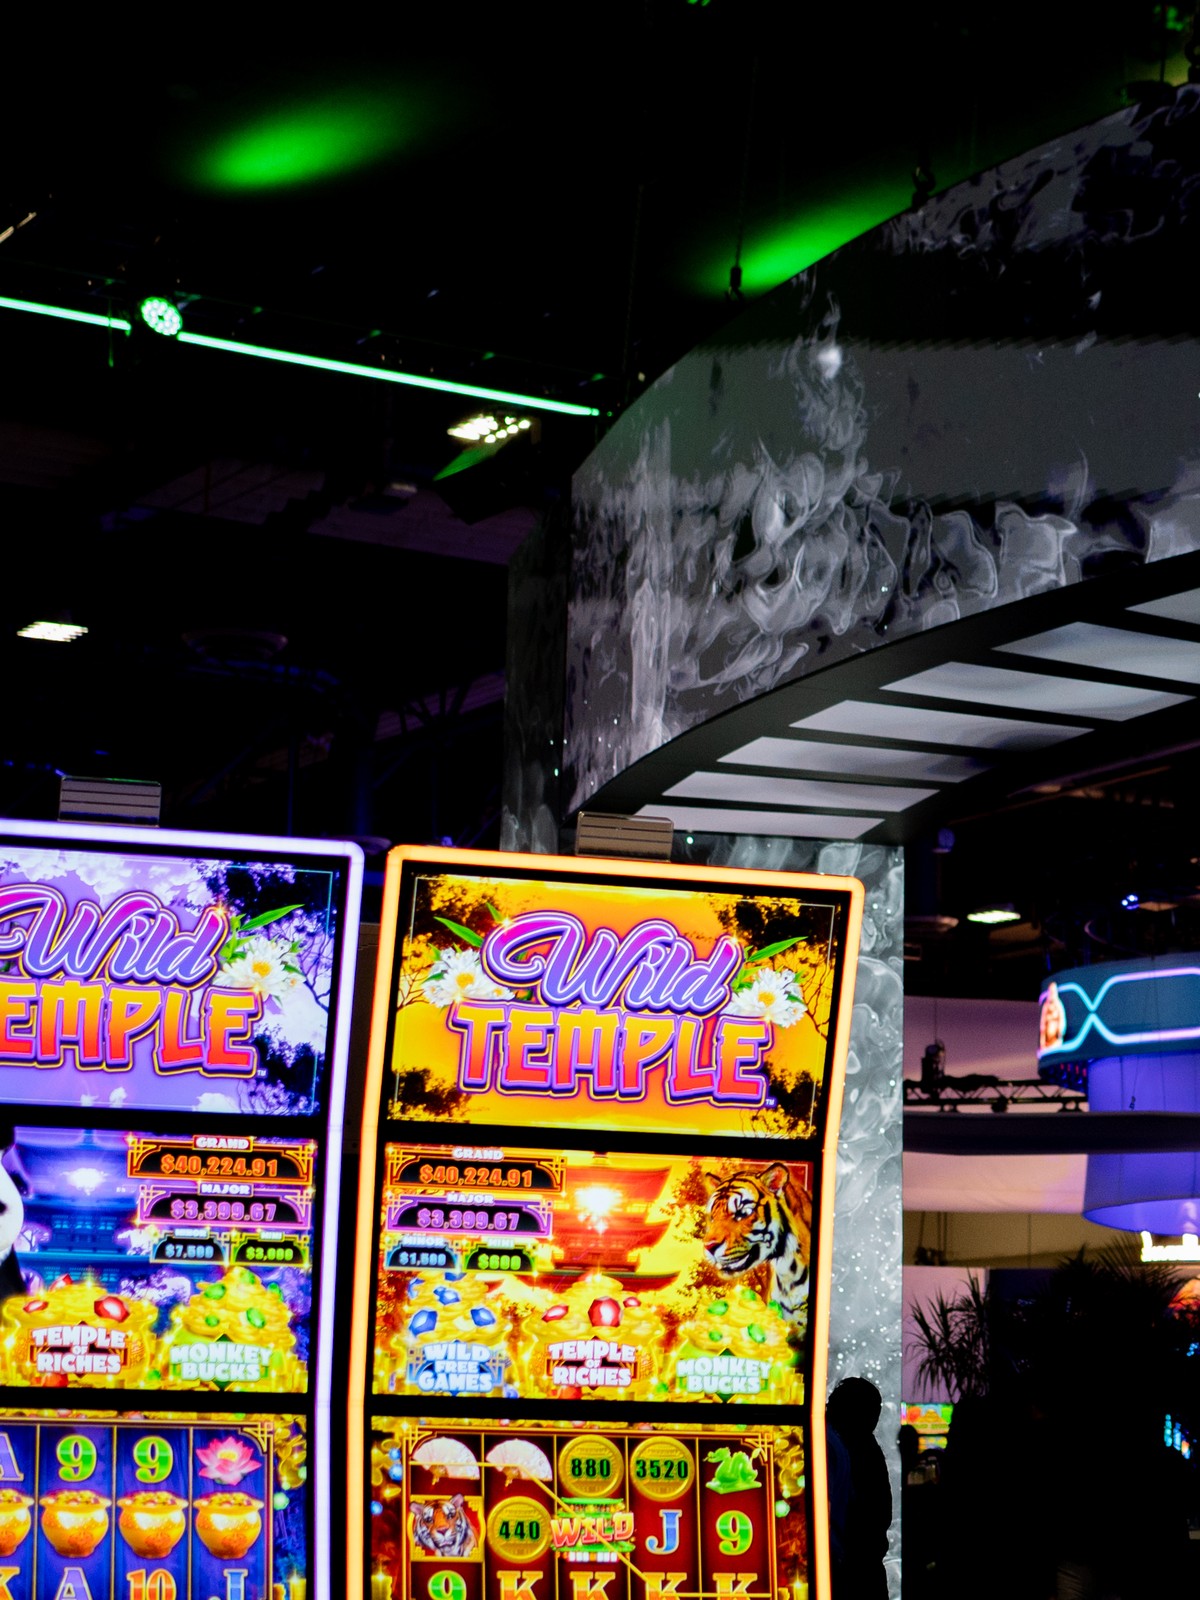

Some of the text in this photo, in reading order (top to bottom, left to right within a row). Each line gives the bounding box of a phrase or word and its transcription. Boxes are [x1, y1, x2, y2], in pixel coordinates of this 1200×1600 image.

[0, 884, 230, 983] Wild
[481, 910, 745, 1015] Wild
[0, 979, 263, 1078] EMPLE
[448, 1000, 774, 1108] TEMPLE
[195, 1137, 249, 1149] GRAND
[452, 1146, 504, 1160] GRAND
[161, 1154, 278, 1177] $40,224.91
[420, 1164, 532, 1187] $40,224.91
[201, 1184, 250, 1195] MAJOR
[446, 1192, 495, 1204] MAJOR
[171, 1199, 277, 1221] $3,399.67
[417, 1208, 520, 1230] $3,399.67
[402, 1235, 445, 1246] MINOR
[32, 1325, 126, 1348] TEMPLE
[72, 1345, 89, 1354] OF
[170, 1342, 273, 1366] MONKEY
[424, 1342, 491, 1361] WILD
[548, 1340, 636, 1361] TEMPLE
[37, 1353, 121, 1374] RICHES
[181, 1362, 260, 1381] BUCKS
[434, 1360, 479, 1373] FREE
[585, 1358, 601, 1368] OF
[676, 1356, 772, 1379] MONKEY
[418, 1371, 493, 1392] GAMES
[553, 1367, 632, 1386] RICHES
[687, 1375, 761, 1394] BUCKS
[56, 1434, 97, 1482] 9
[133, 1436, 174, 1484] 9
[571, 1458, 611, 1478] 880
[636, 1459, 689, 1479] 3520
[499, 1520, 541, 1540] 440
[550, 1511, 634, 1548] WILD
[645, 1508, 683, 1555] J
[716, 1510, 753, 1556] 9
[55, 1566, 93, 1600] A
[127, 1568, 177, 1600] 10
[496, 1570, 543, 1600] K
[569, 1571, 616, 1600] K
[642, 1572, 687, 1600] K
[712, 1572, 758, 1600] K
